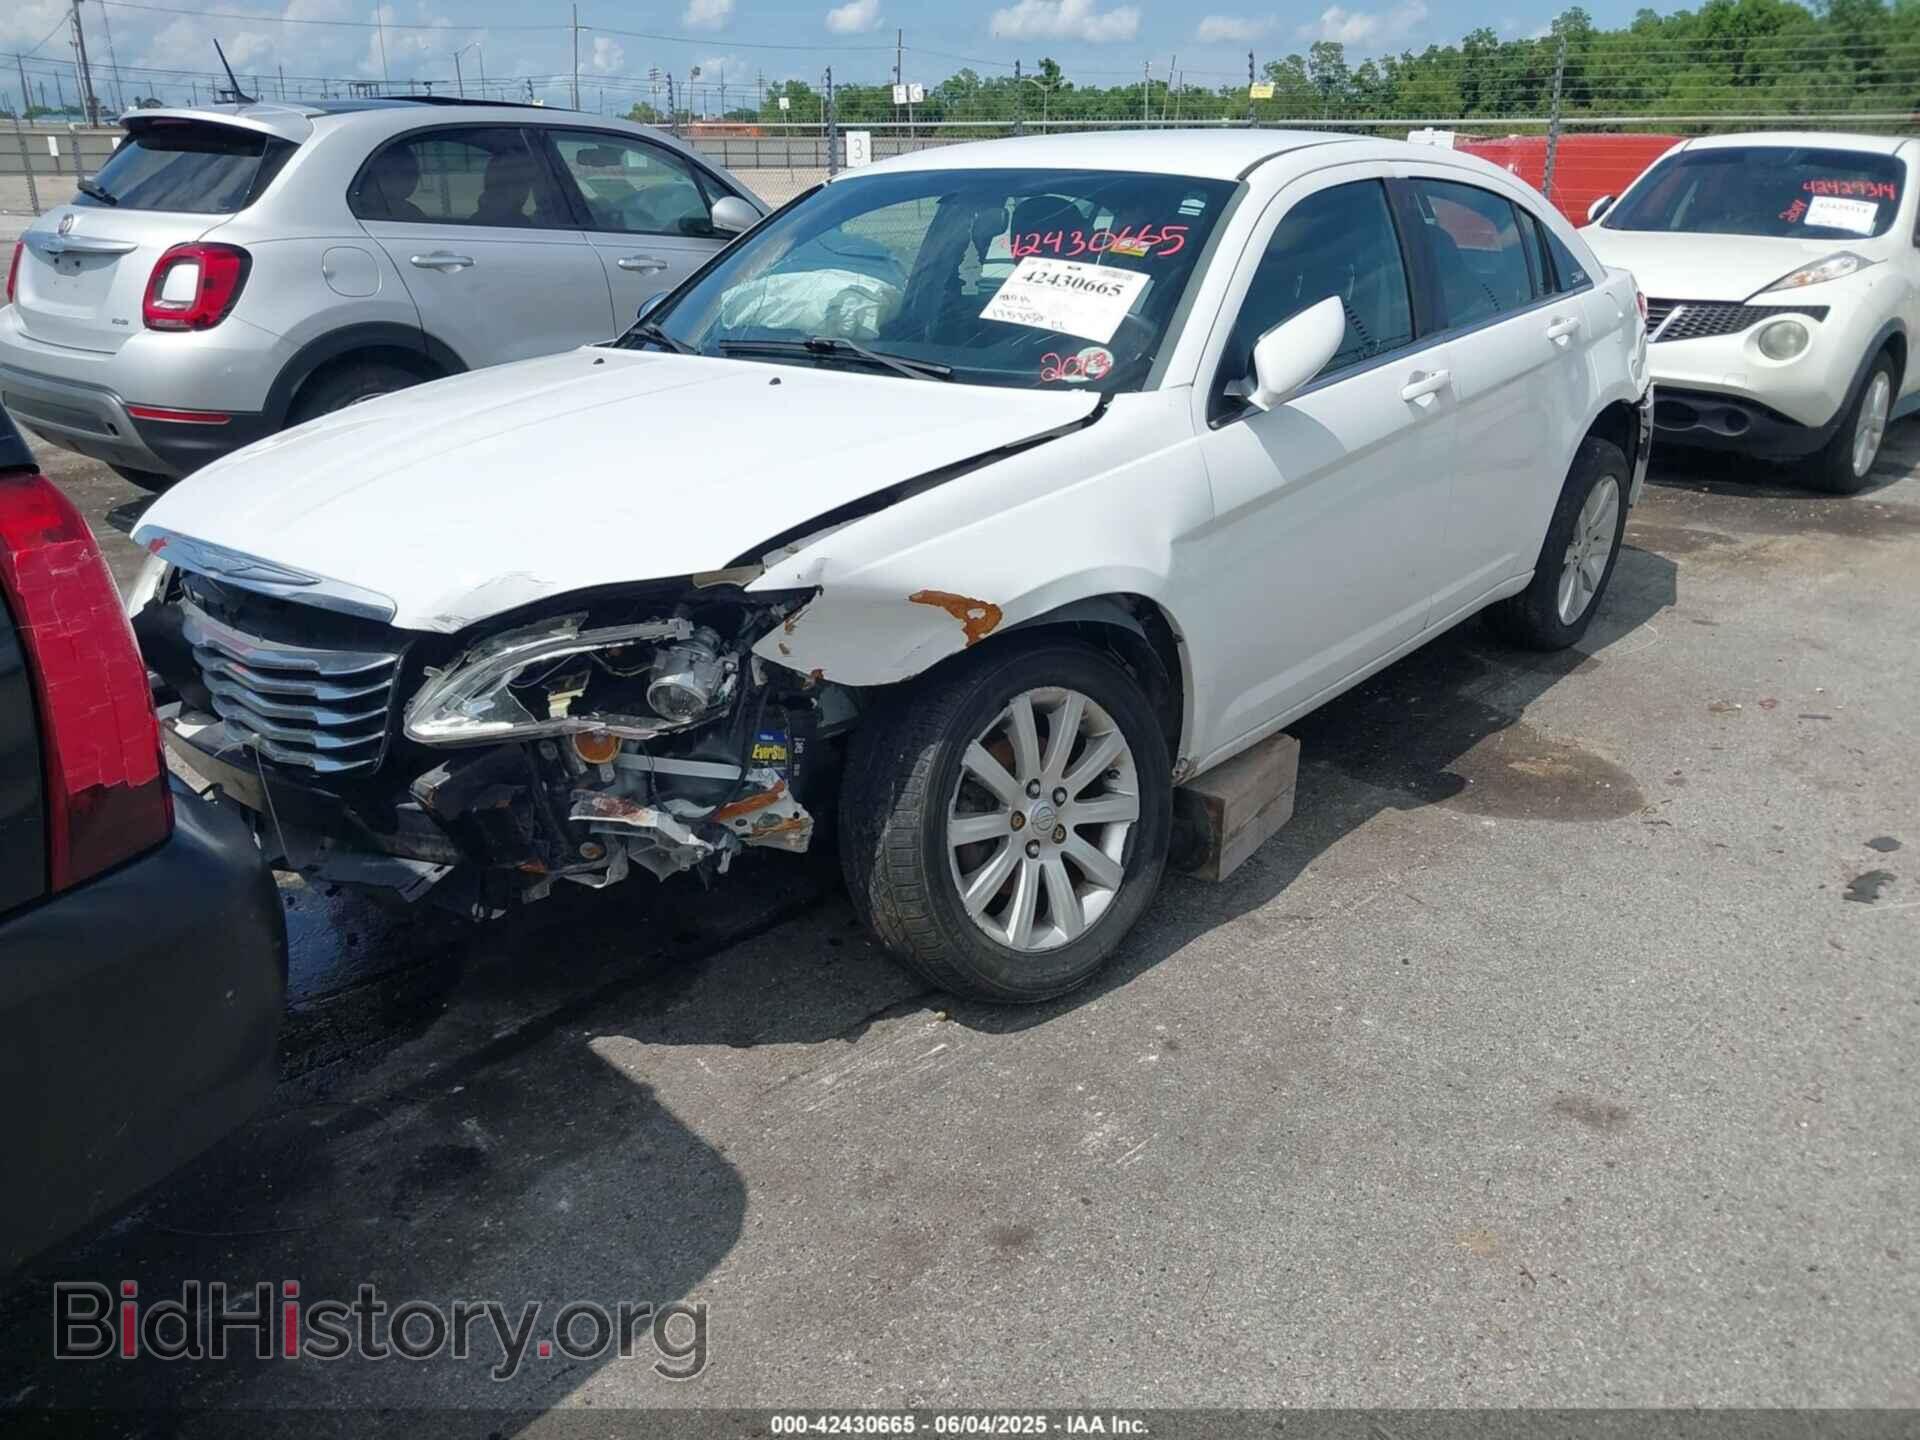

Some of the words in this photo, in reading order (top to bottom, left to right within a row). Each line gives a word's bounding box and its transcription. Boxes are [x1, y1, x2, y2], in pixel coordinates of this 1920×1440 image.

[854, 138, 864, 160] 3
[1001, 224, 1190, 257] 42430665
[1022, 271, 1125, 297] 42430665
